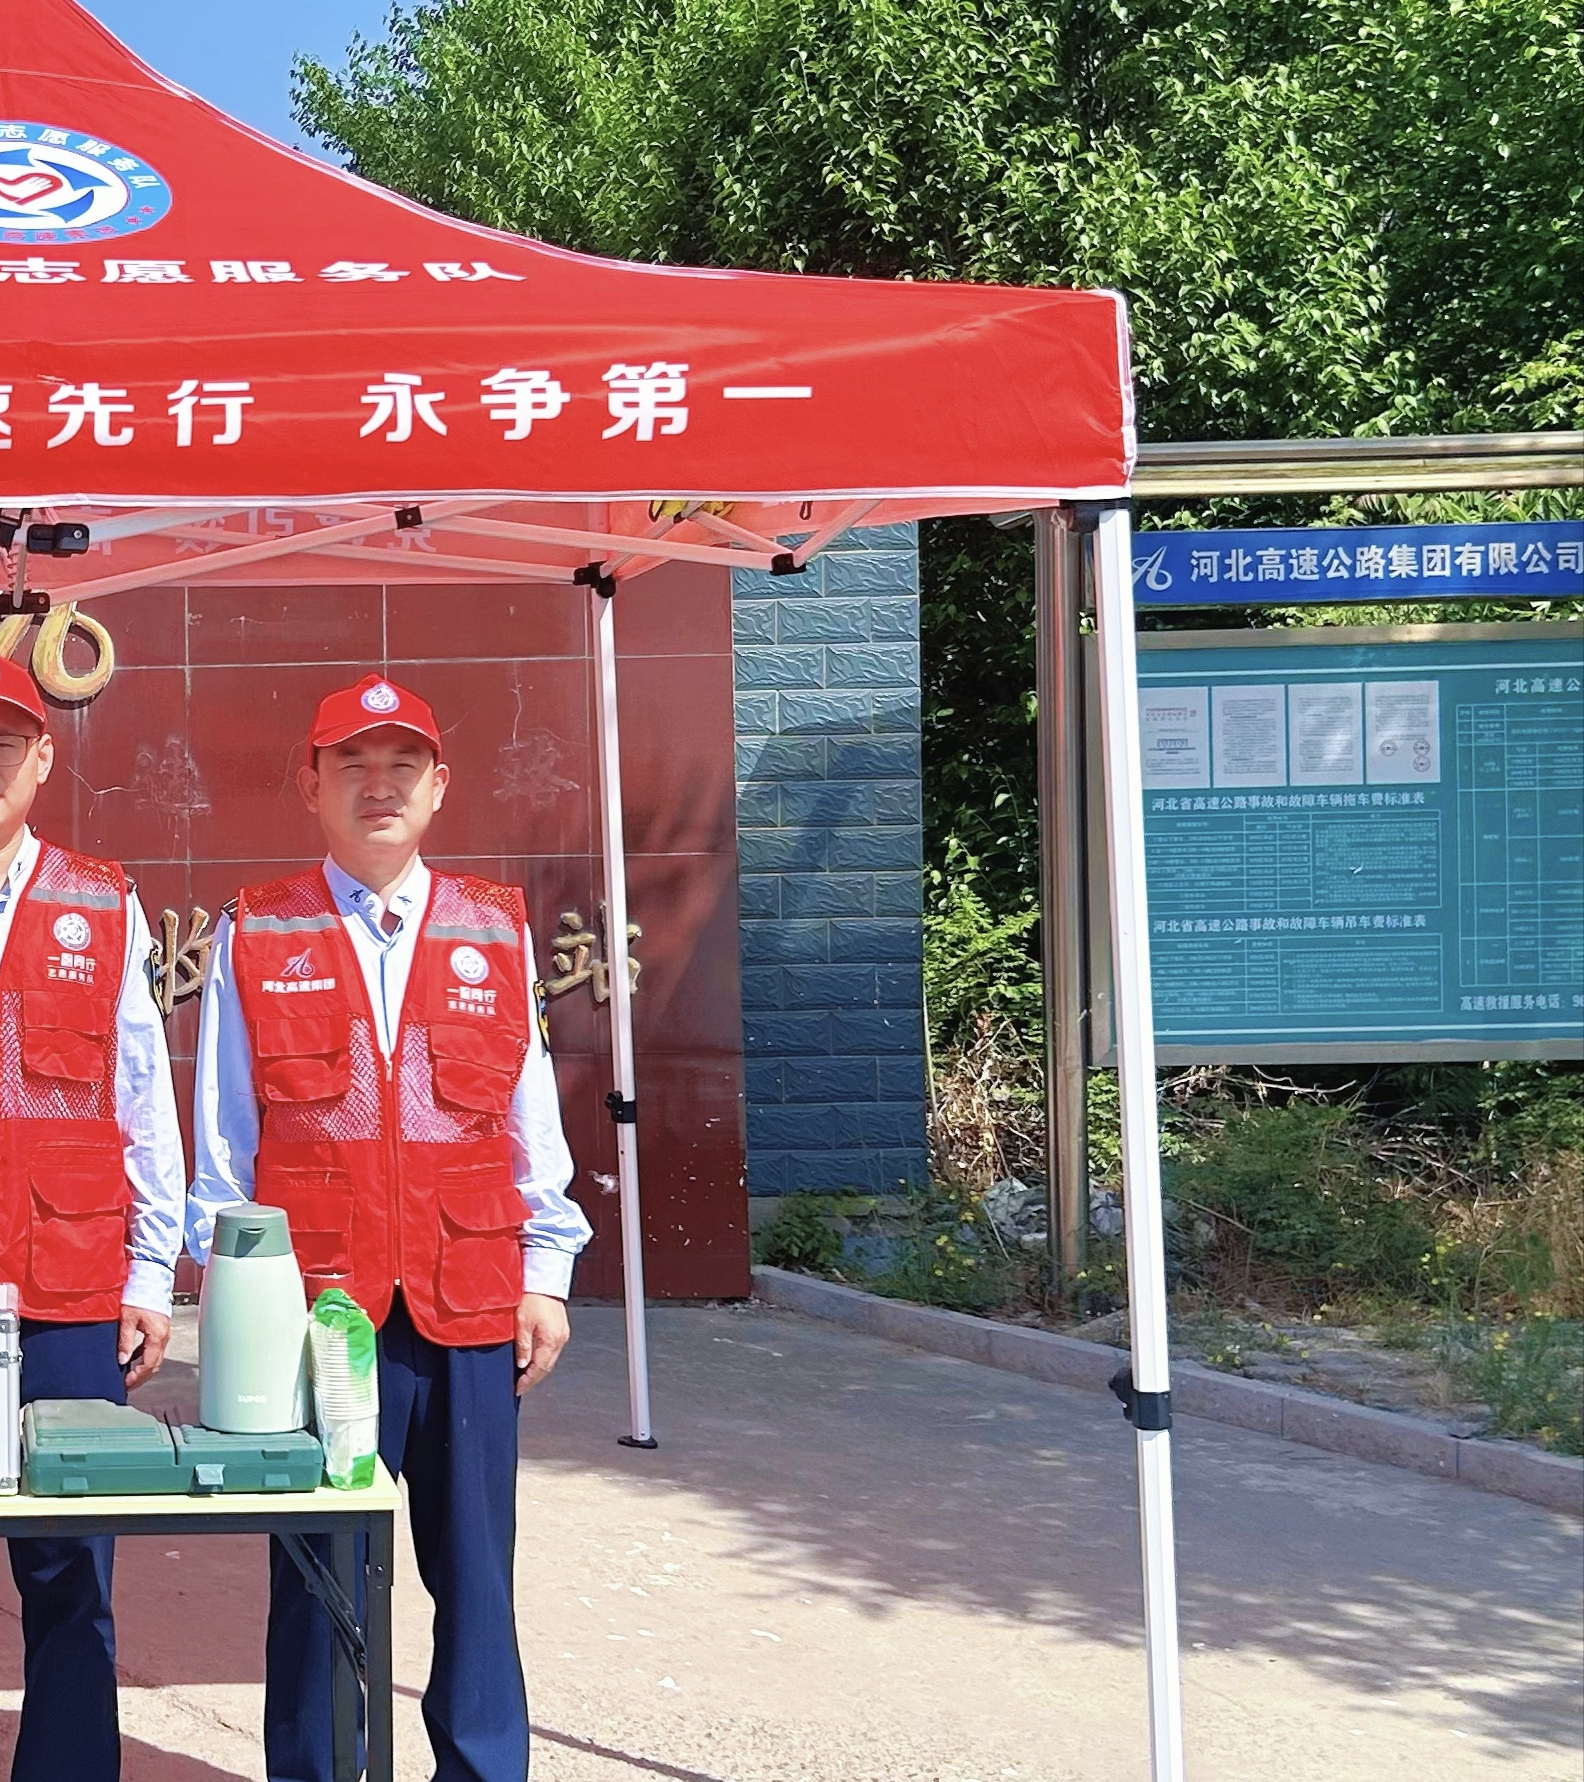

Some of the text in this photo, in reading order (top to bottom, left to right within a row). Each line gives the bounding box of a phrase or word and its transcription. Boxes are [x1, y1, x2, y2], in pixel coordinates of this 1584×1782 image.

[360, 362, 813, 442] 永争第一
[1190, 541, 1584, 583] 河北高速公路集团有限公司
